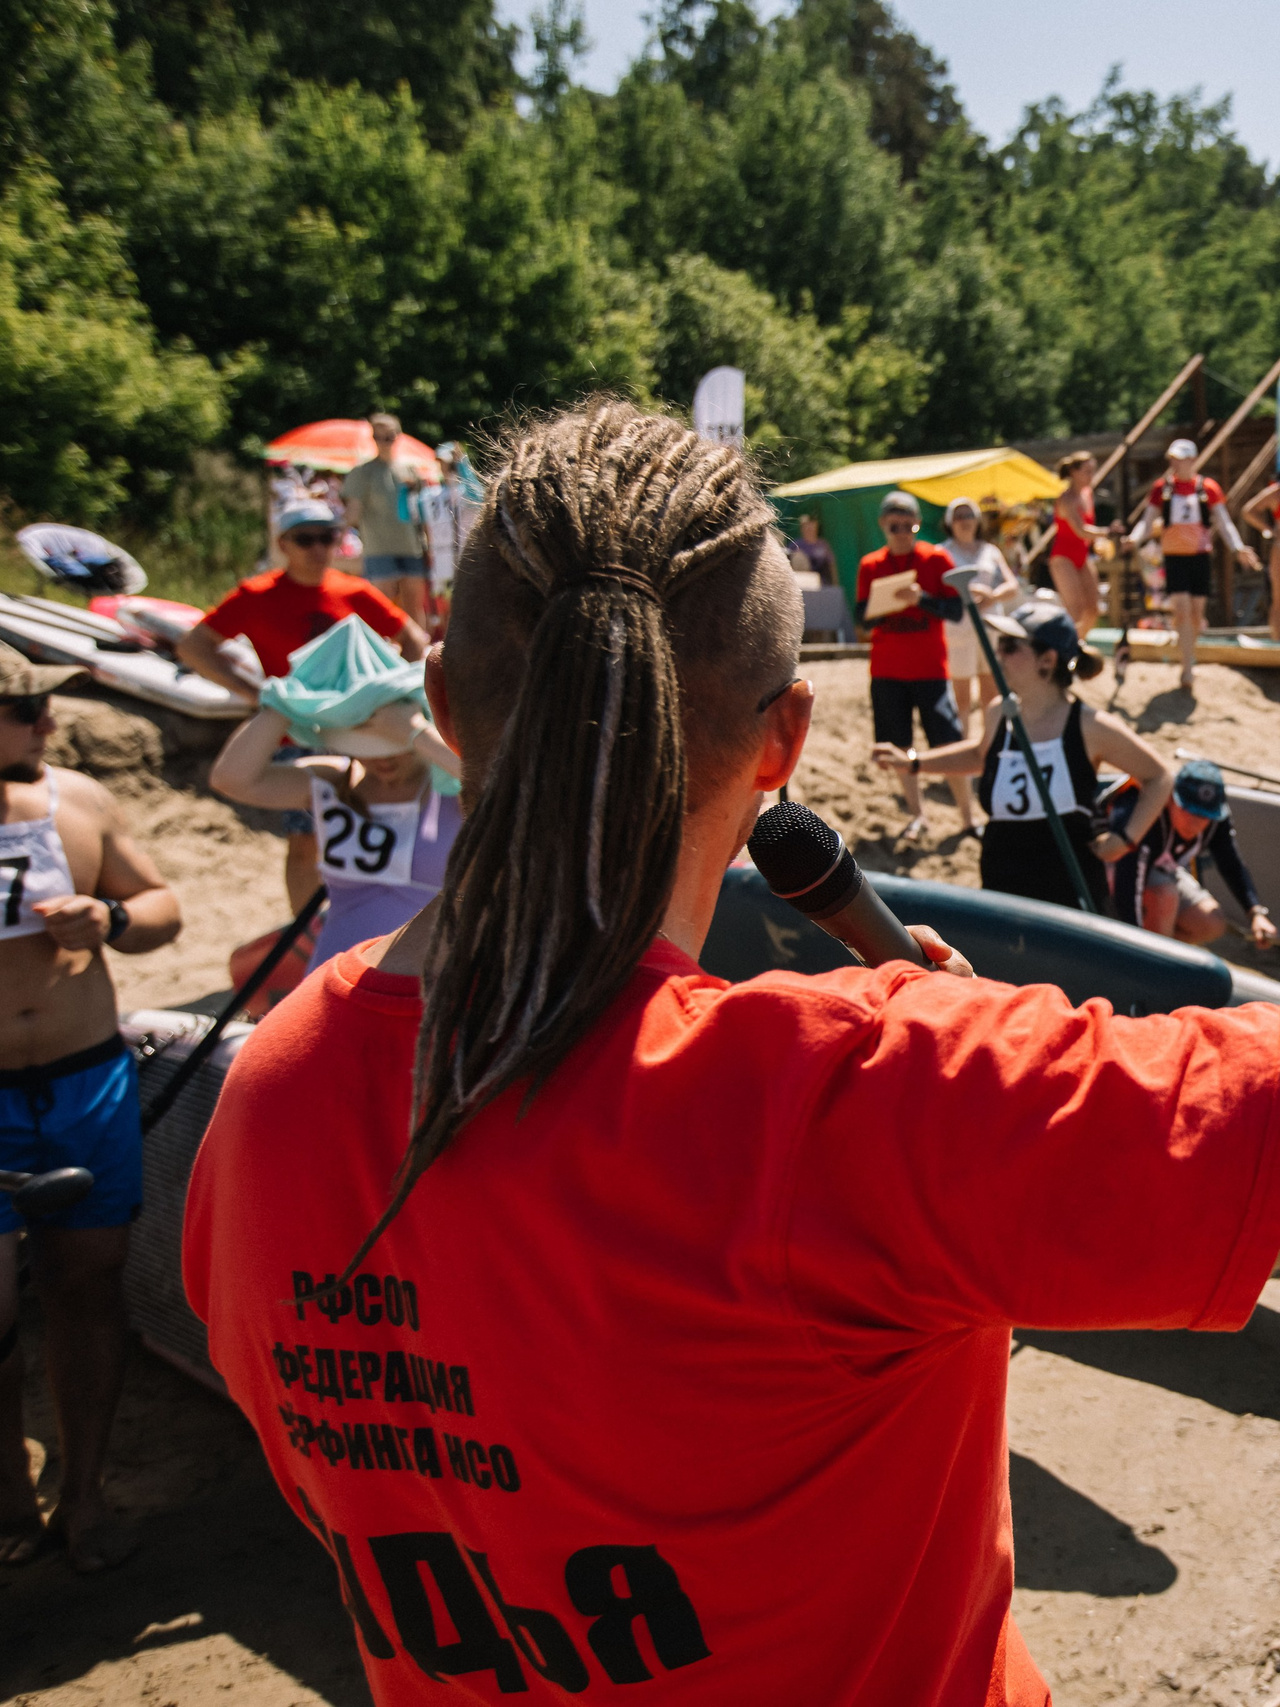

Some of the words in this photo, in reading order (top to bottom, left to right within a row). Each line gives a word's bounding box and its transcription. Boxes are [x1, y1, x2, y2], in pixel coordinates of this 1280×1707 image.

[1006, 764, 1054, 816] 37
[323, 807, 397, 874] 29
[272, 1341, 476, 1417] ФЕДЕРАЦИЯ
[443, 1431, 522, 1493] НСО
